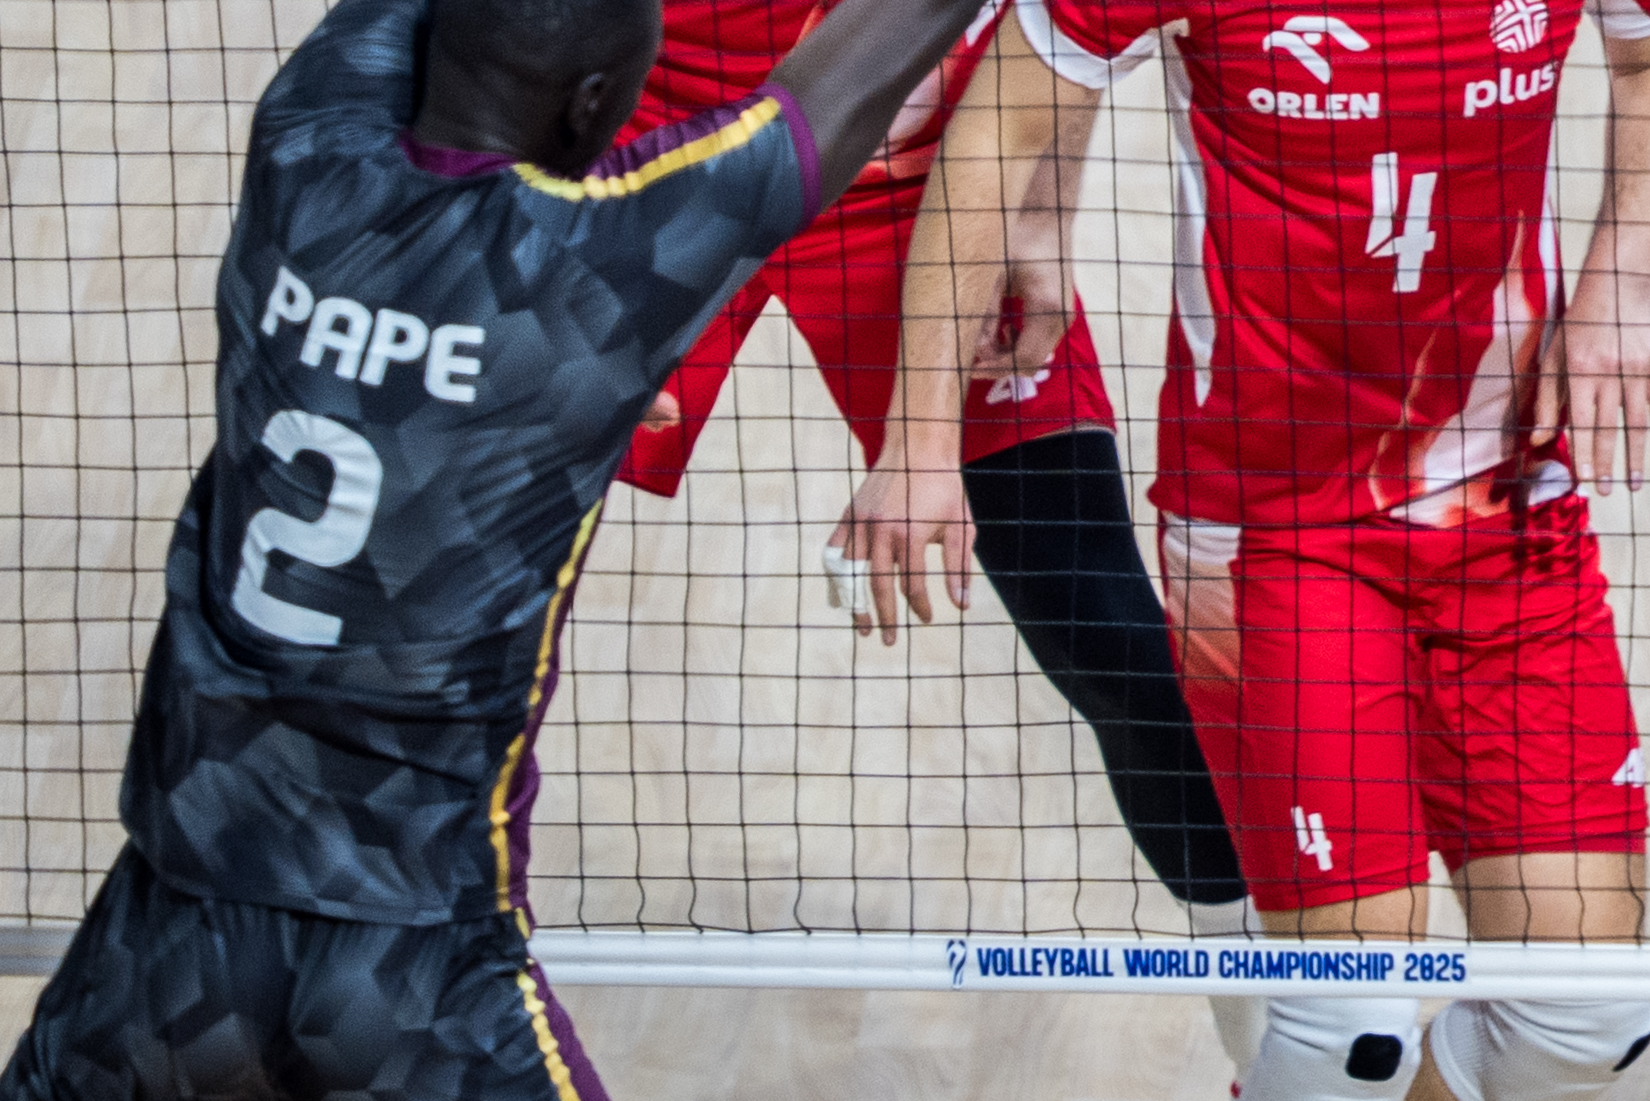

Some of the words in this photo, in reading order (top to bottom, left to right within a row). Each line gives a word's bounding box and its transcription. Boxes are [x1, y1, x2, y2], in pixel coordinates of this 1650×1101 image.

[1247, 87, 1380, 120] ORLEN
[1463, 61, 1560, 117] plus
[1364, 151, 1438, 293] 4
[260, 265, 486, 402] PAPE
[232, 408, 383, 646] 2
[1290, 805, 1334, 872] 4
[977, 948, 1114, 977] VOLLEYBALL
[1124, 949, 1209, 978] WORLD
[1219, 950, 1394, 981] CHAMPIONSHIP
[1404, 952, 1466, 982] 2025
